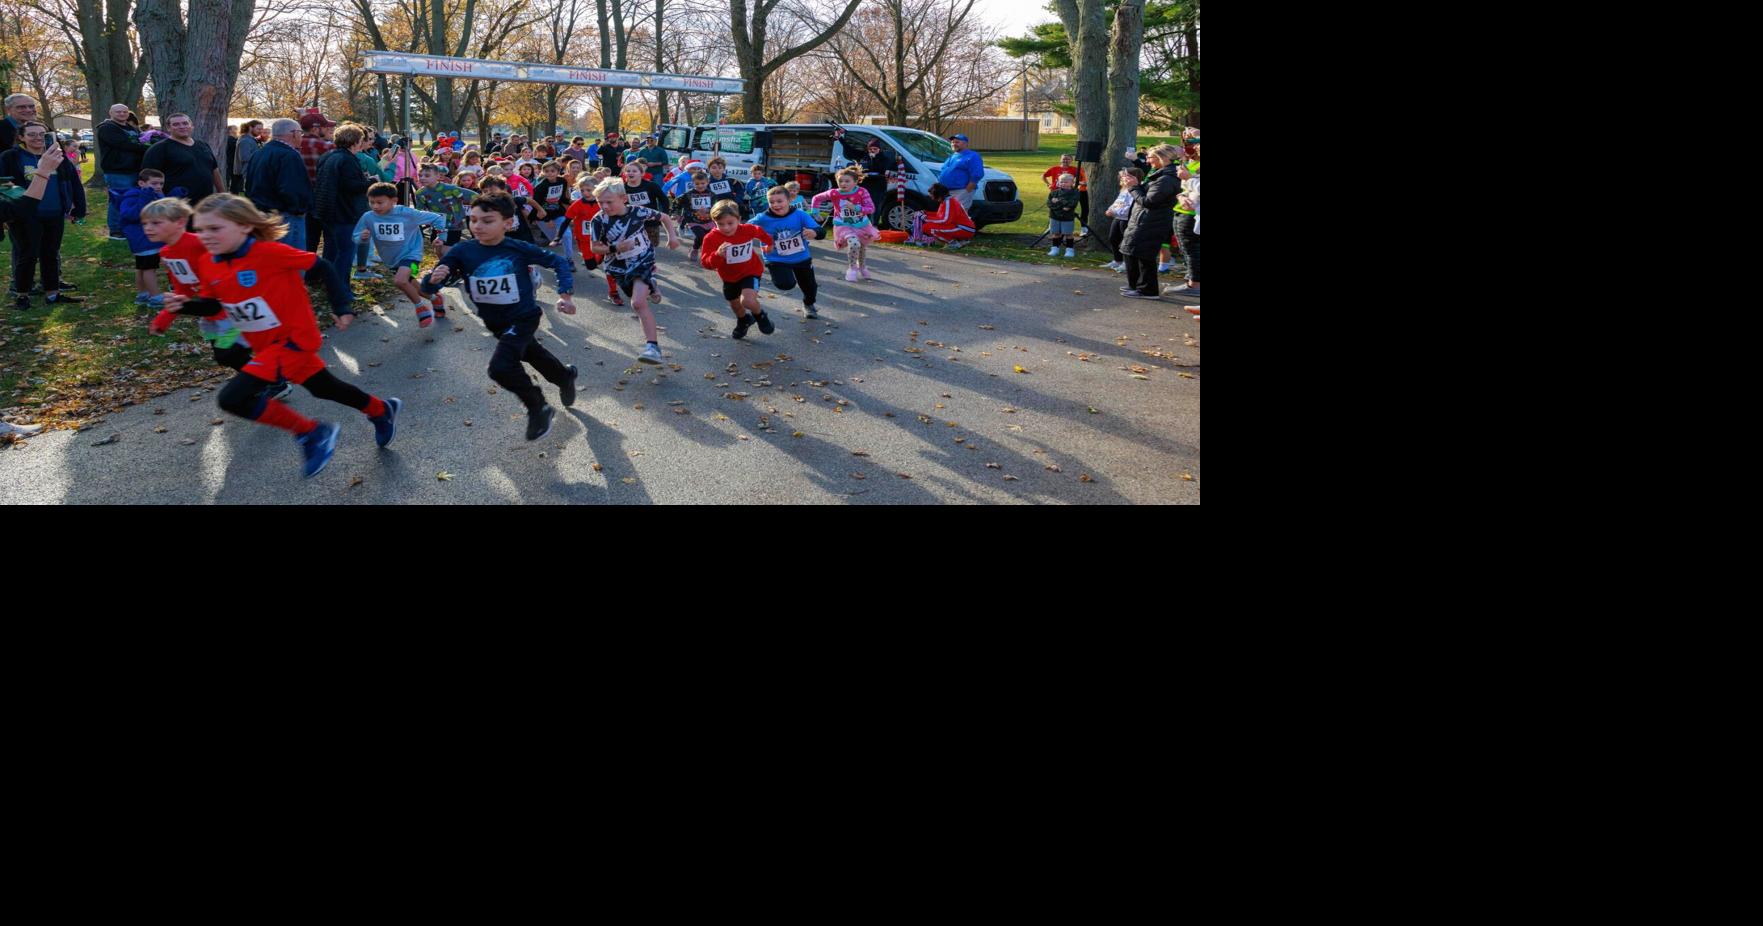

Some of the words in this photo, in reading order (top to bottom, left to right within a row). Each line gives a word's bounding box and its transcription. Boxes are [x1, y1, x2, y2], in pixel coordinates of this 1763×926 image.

[426, 59, 473, 73] FINISH
[569, 70, 606, 82] FINISH
[683, 78, 714, 89] FINISH
[712, 181, 728, 191] 653
[630, 192, 646, 202] 636
[694, 198, 709, 206] 671
[378, 223, 400, 236] 658
[731, 242, 752, 258] 677
[779, 237, 800, 251] 678
[476, 277, 512, 295] 624
